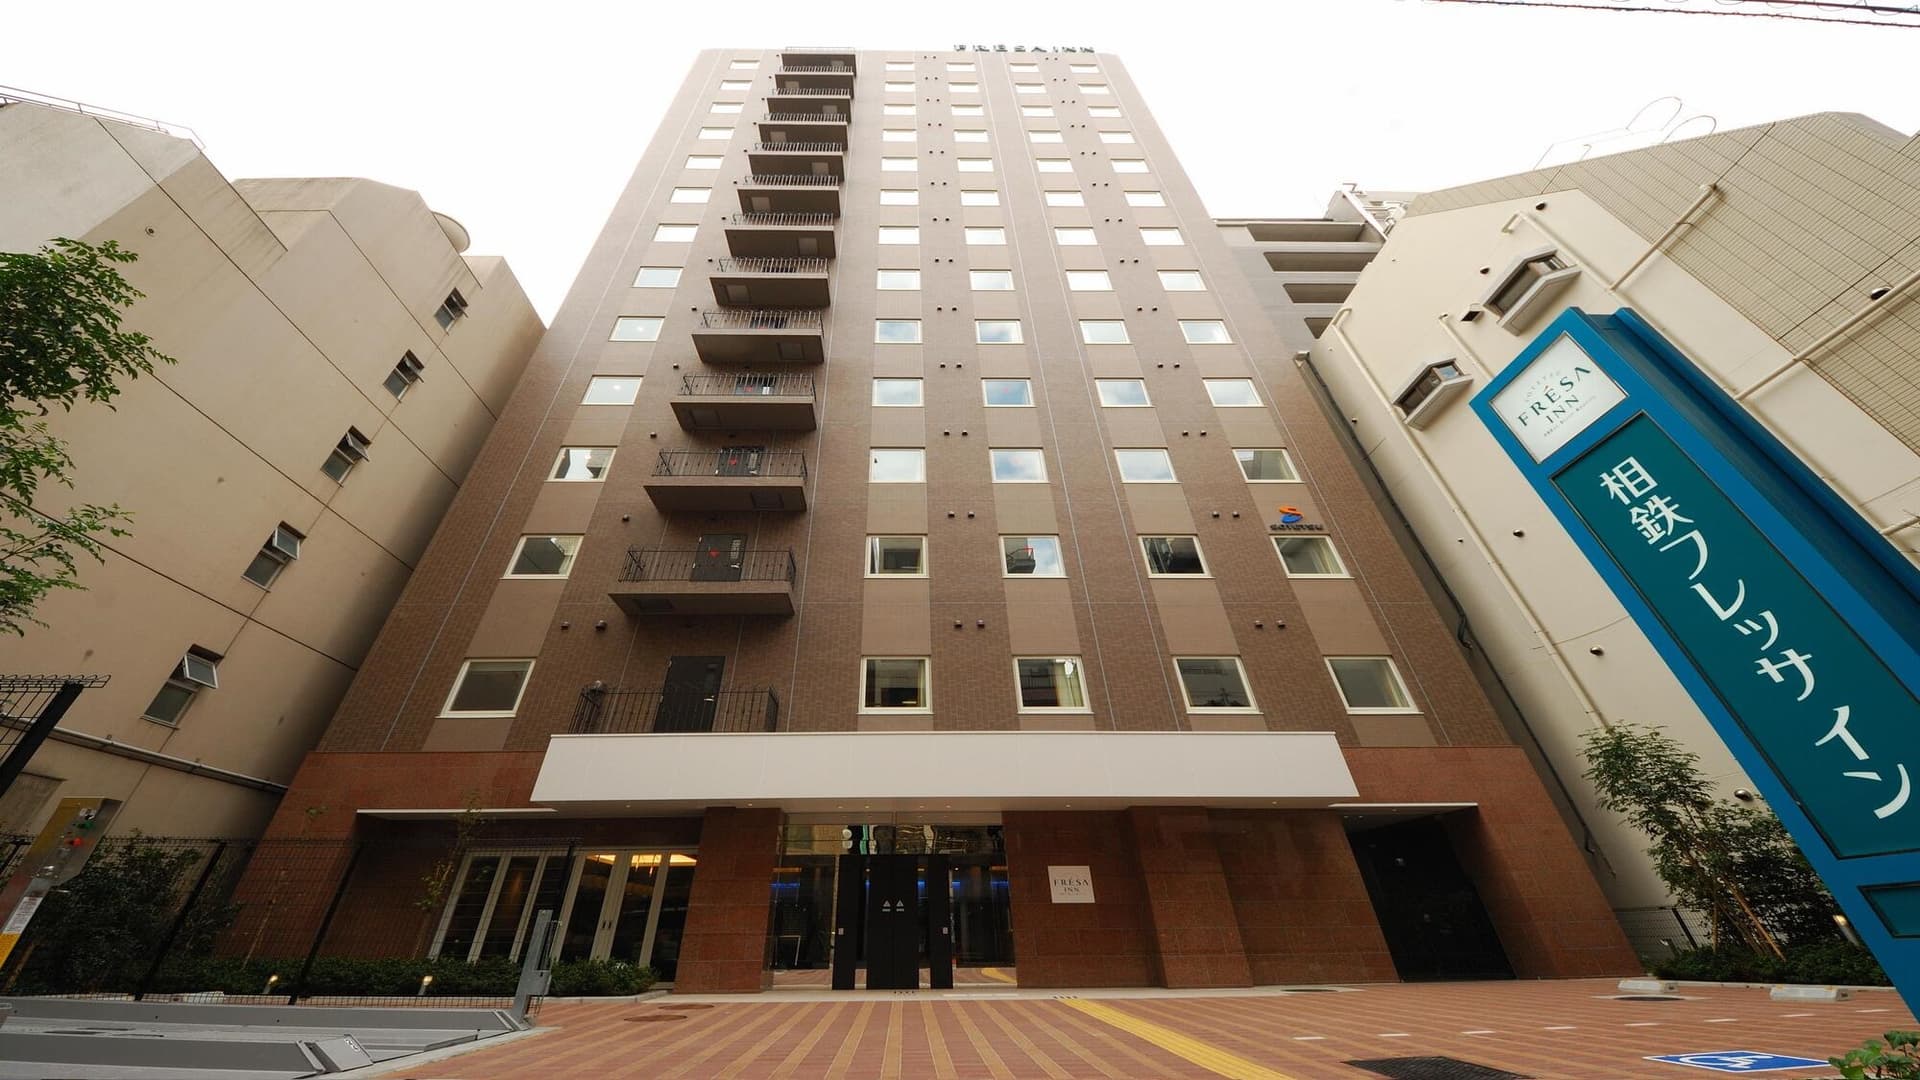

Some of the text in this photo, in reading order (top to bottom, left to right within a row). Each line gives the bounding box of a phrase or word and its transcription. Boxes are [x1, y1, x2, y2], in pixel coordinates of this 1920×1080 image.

[1545, 394, 1579, 424] INN
[1600, 456, 1911, 819] 相鉄フレッサイン
